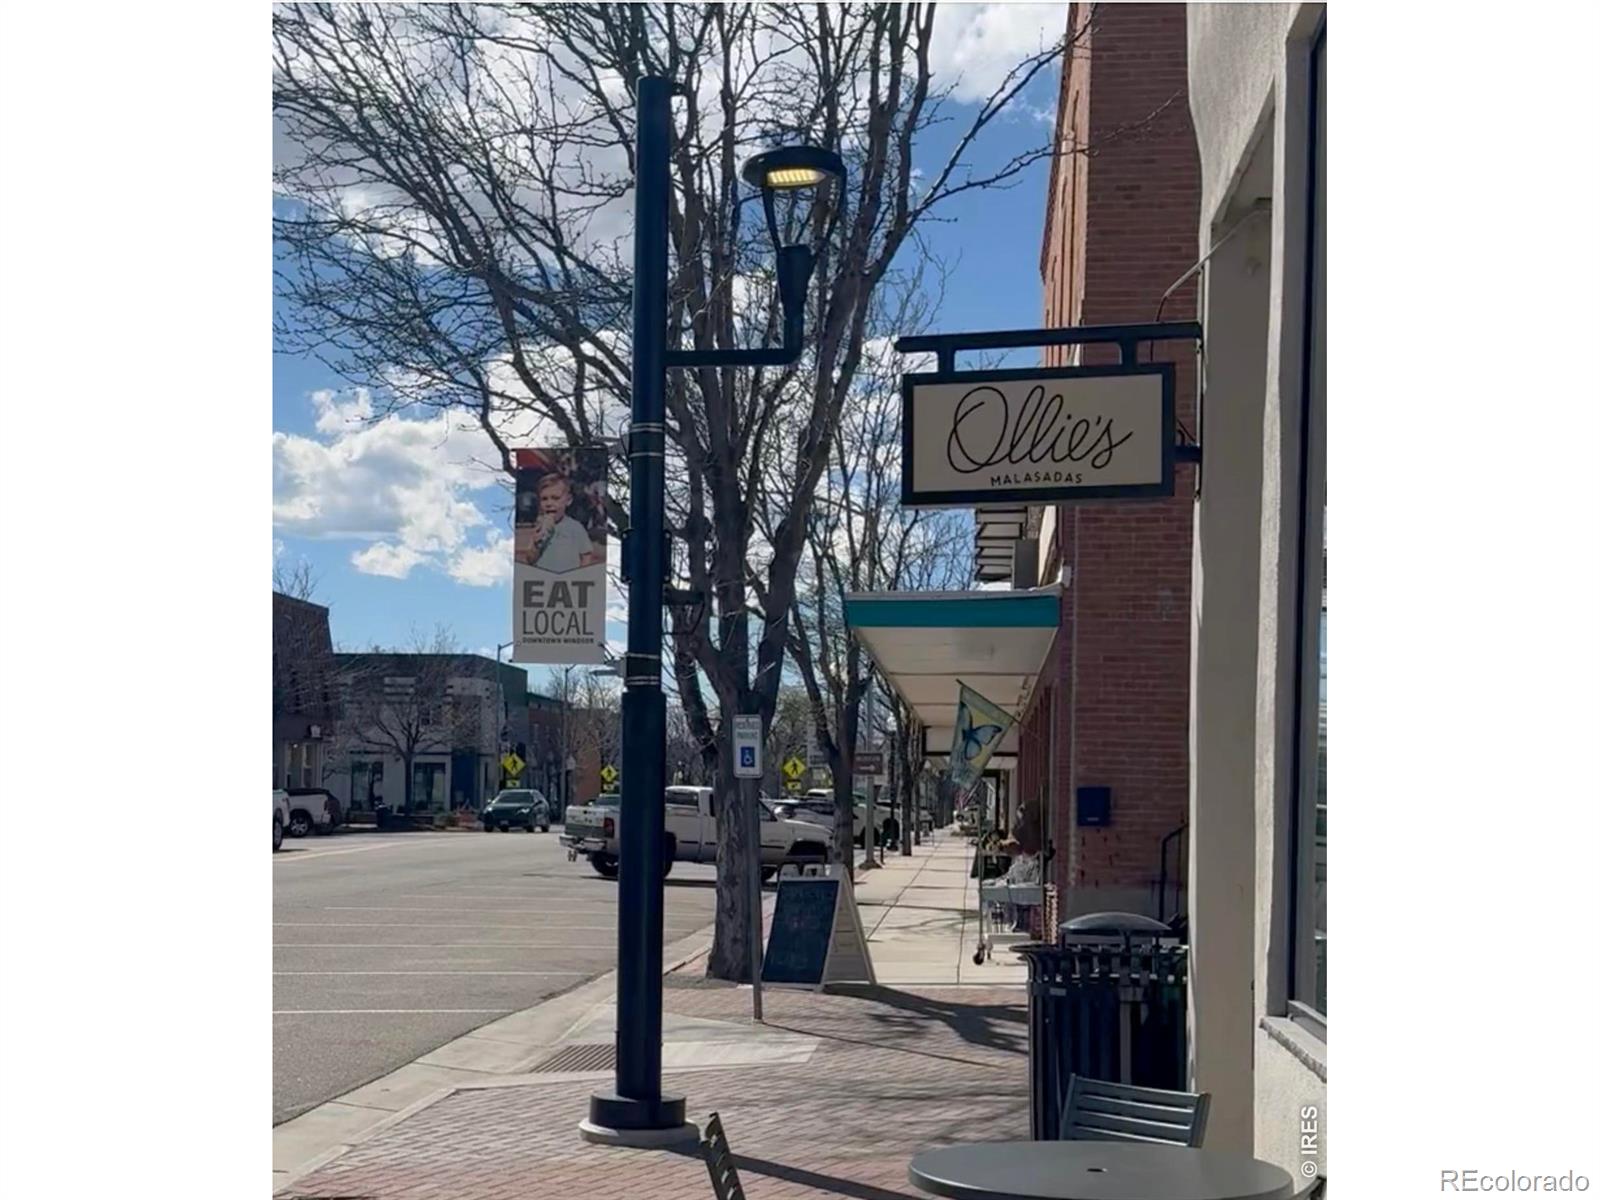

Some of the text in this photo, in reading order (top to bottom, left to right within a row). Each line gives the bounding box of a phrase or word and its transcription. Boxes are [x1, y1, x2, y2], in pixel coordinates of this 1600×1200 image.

[947, 385, 1133, 473] Ollie's
[990, 473, 1083, 487] MALASADAS
[523, 580, 595, 608] EAT
[522, 610, 594, 635] LOCAL
